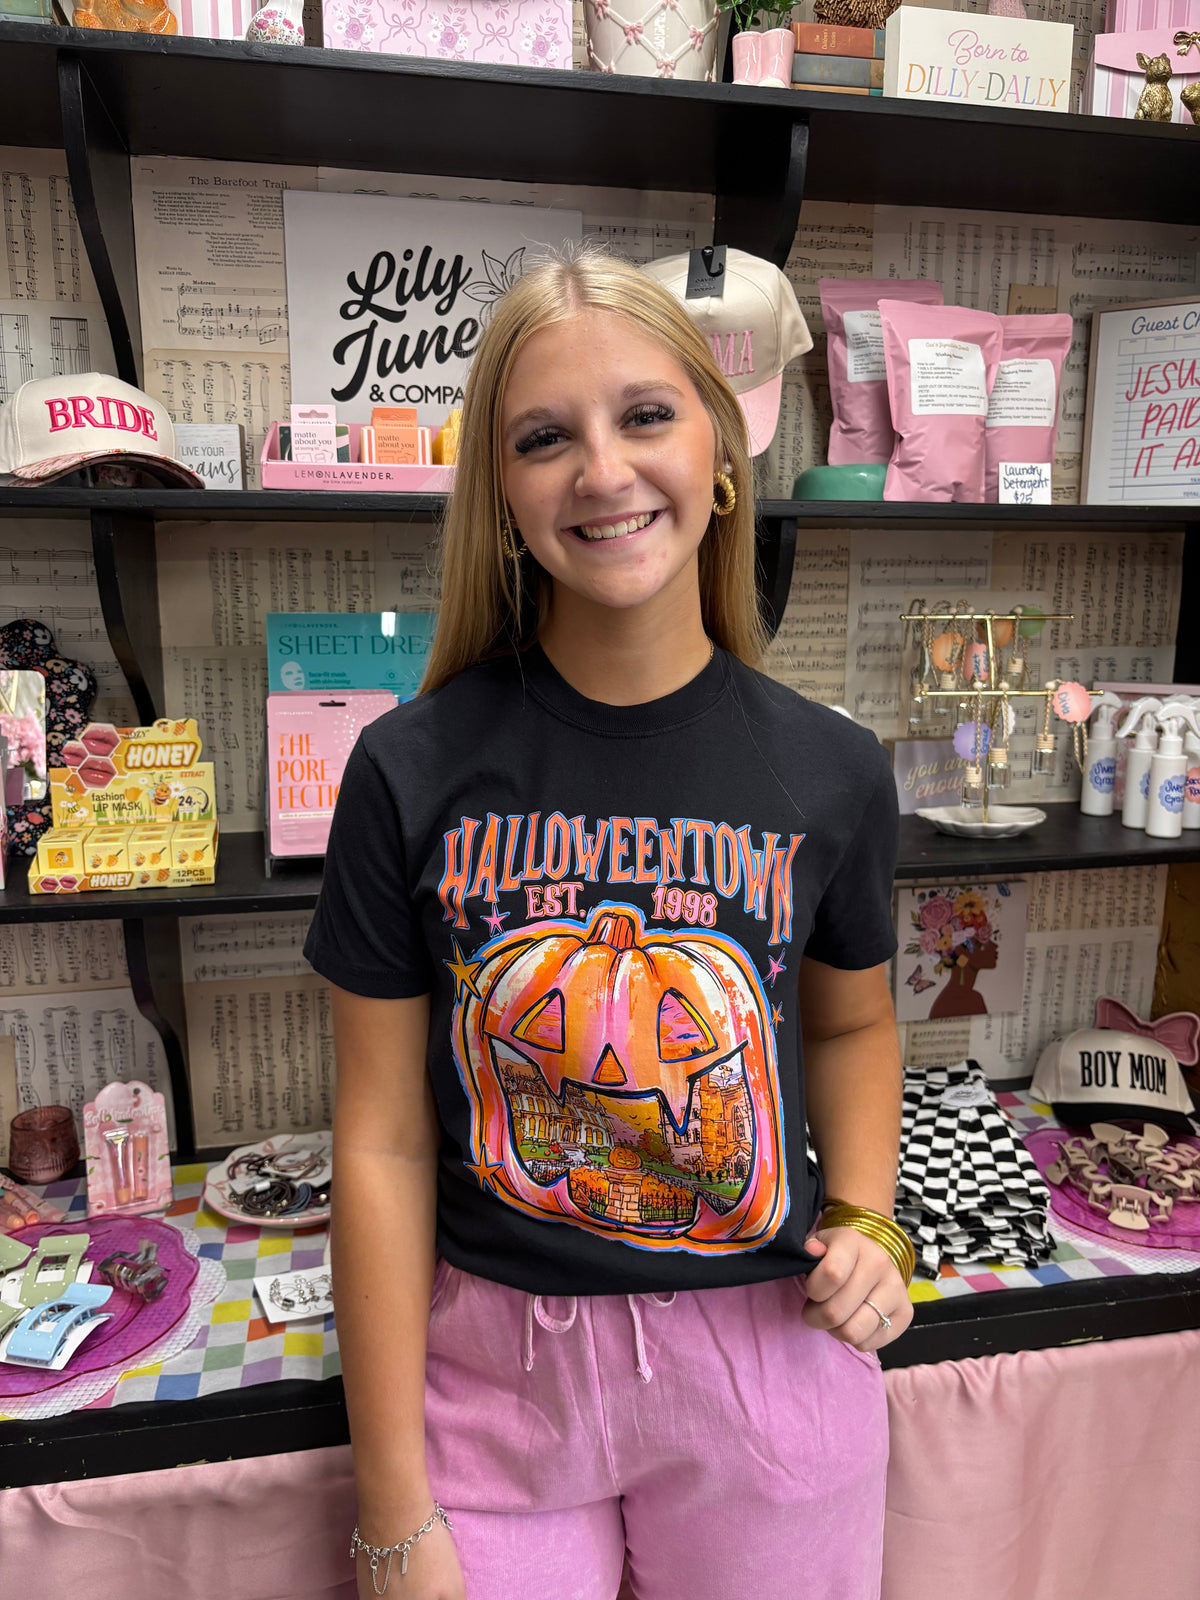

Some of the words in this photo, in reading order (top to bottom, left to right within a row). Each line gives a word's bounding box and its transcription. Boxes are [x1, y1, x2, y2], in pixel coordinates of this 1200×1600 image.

[948, 30, 1007, 65] Born
[1011, 43, 1030, 63] to
[905, 63, 1066, 107] DILLY-DALLY
[189, 176, 209, 186] The
[213, 177, 258, 188] Barefoot
[339, 245, 472, 323] Lily
[1131, 316, 1179, 335] Guest
[331, 319, 482, 402] June
[369, 384, 386, 402] &
[45, 396, 158, 441] BRIDE
[181, 446, 200, 457] LIVE
[201, 446, 225, 457] YOUR
[295, 438, 317, 446] about
[318, 439, 333, 447] you
[378, 441, 401, 449] about
[402, 442, 415, 451] you
[1133, 443, 1164, 479] IT
[1003, 477, 1050, 496] Detergent
[1014, 491, 1034, 504] $25
[277, 635, 364, 656] SHEET
[1057, 692, 1070, 715] Diva
[126, 742, 198, 769] HONEY
[277, 733, 318, 756] THE
[904, 761, 940, 792] you
[91, 792, 125, 802] fashion
[92, 803, 108, 813] LIP
[112, 801, 142, 812] MASK
[90, 872, 133, 888] HONEY
[176, 869, 205, 878] 12PCS
[438, 811, 806, 946] HALLOWEENTOWN
[524, 882, 587, 920] EST.
[651, 885, 718, 928] 1998
[1079, 1050, 1122, 1088] BOY
[1128, 1052, 1168, 1096] MOM
